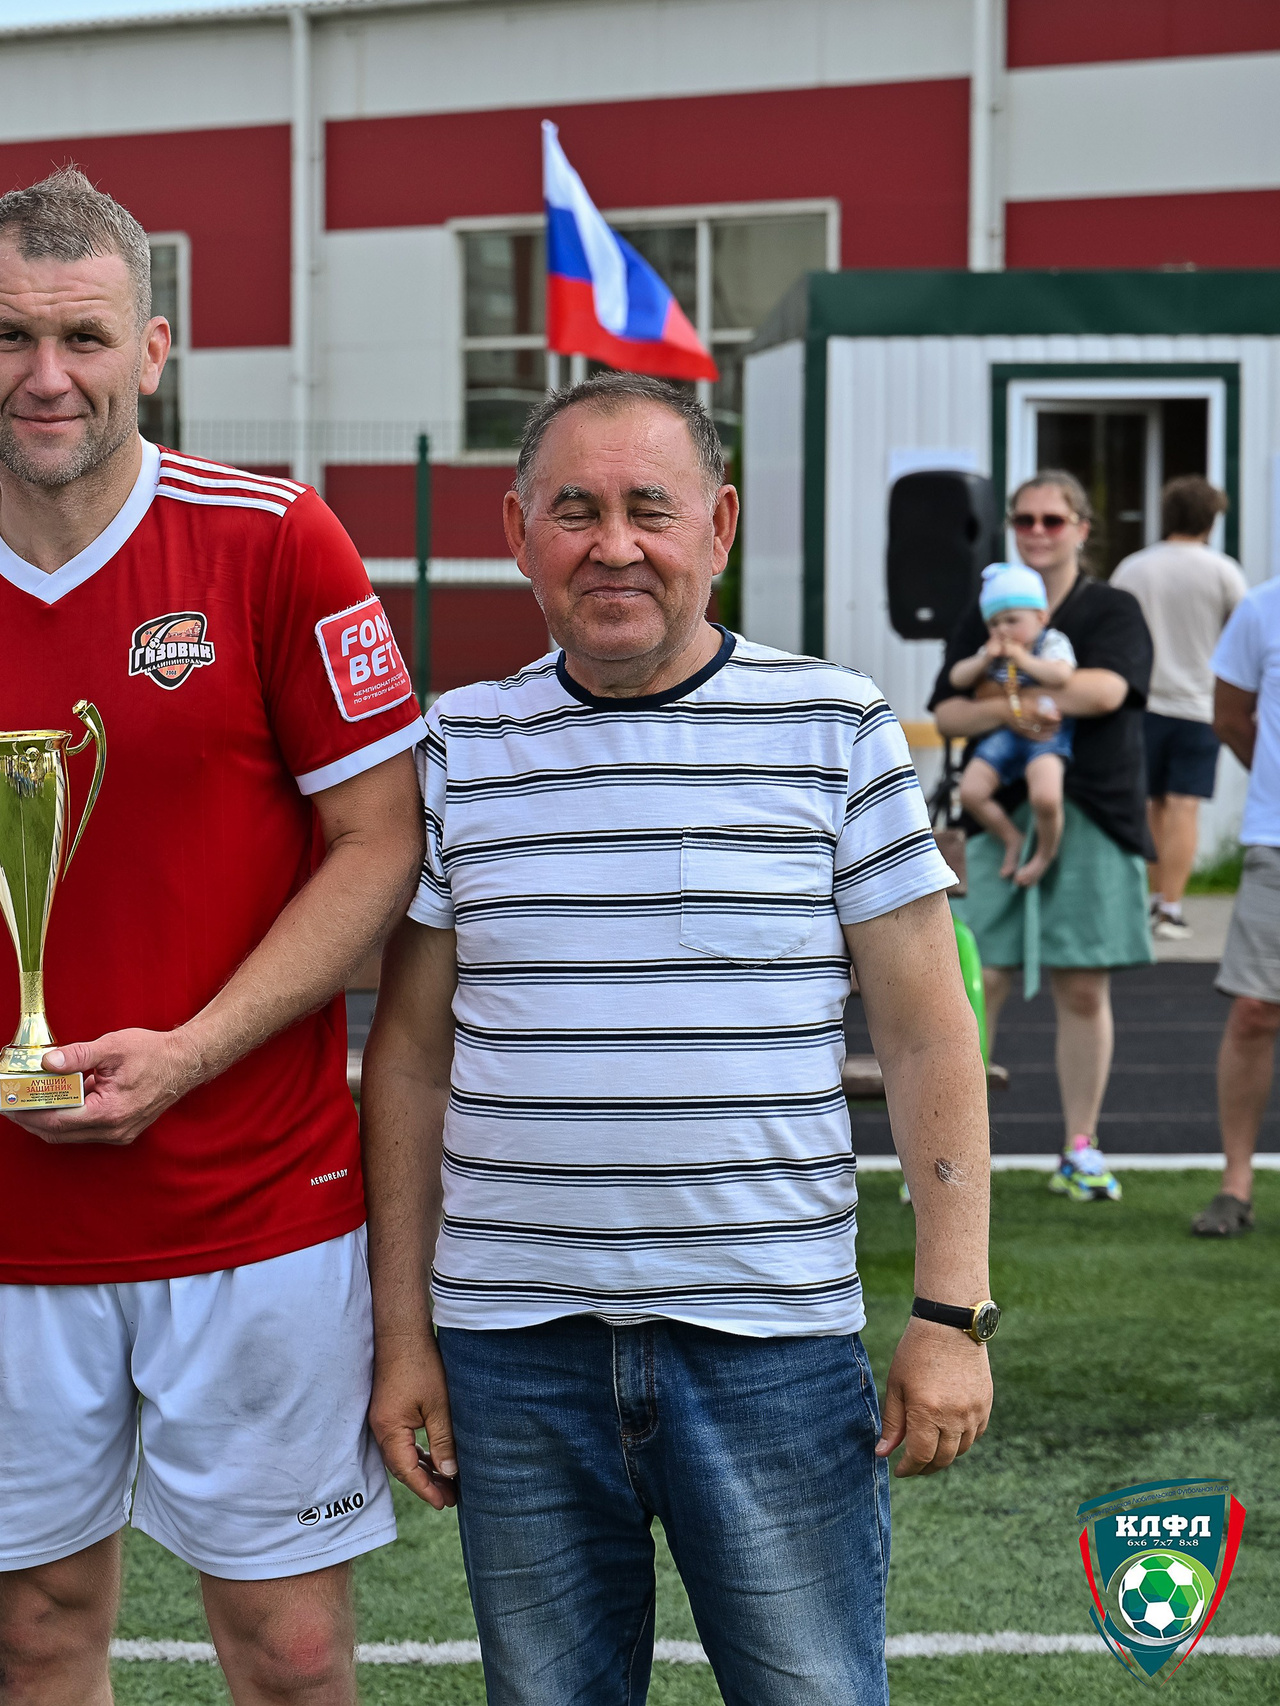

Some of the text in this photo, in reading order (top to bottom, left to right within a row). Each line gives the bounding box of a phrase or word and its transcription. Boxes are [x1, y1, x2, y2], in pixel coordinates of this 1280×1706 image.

[341, 611, 391, 657] FON
[134, 642, 212, 669] ГАЗОВИК
[349, 640, 397, 686] BET
[26, 1084, 72, 1093] ЗАЩИТНИК
[30, 1077, 67, 1087] ЛУЧШИЙ
[310, 1169, 348, 1186] AEROREADY
[325, 1492, 364, 1519] JAKO
